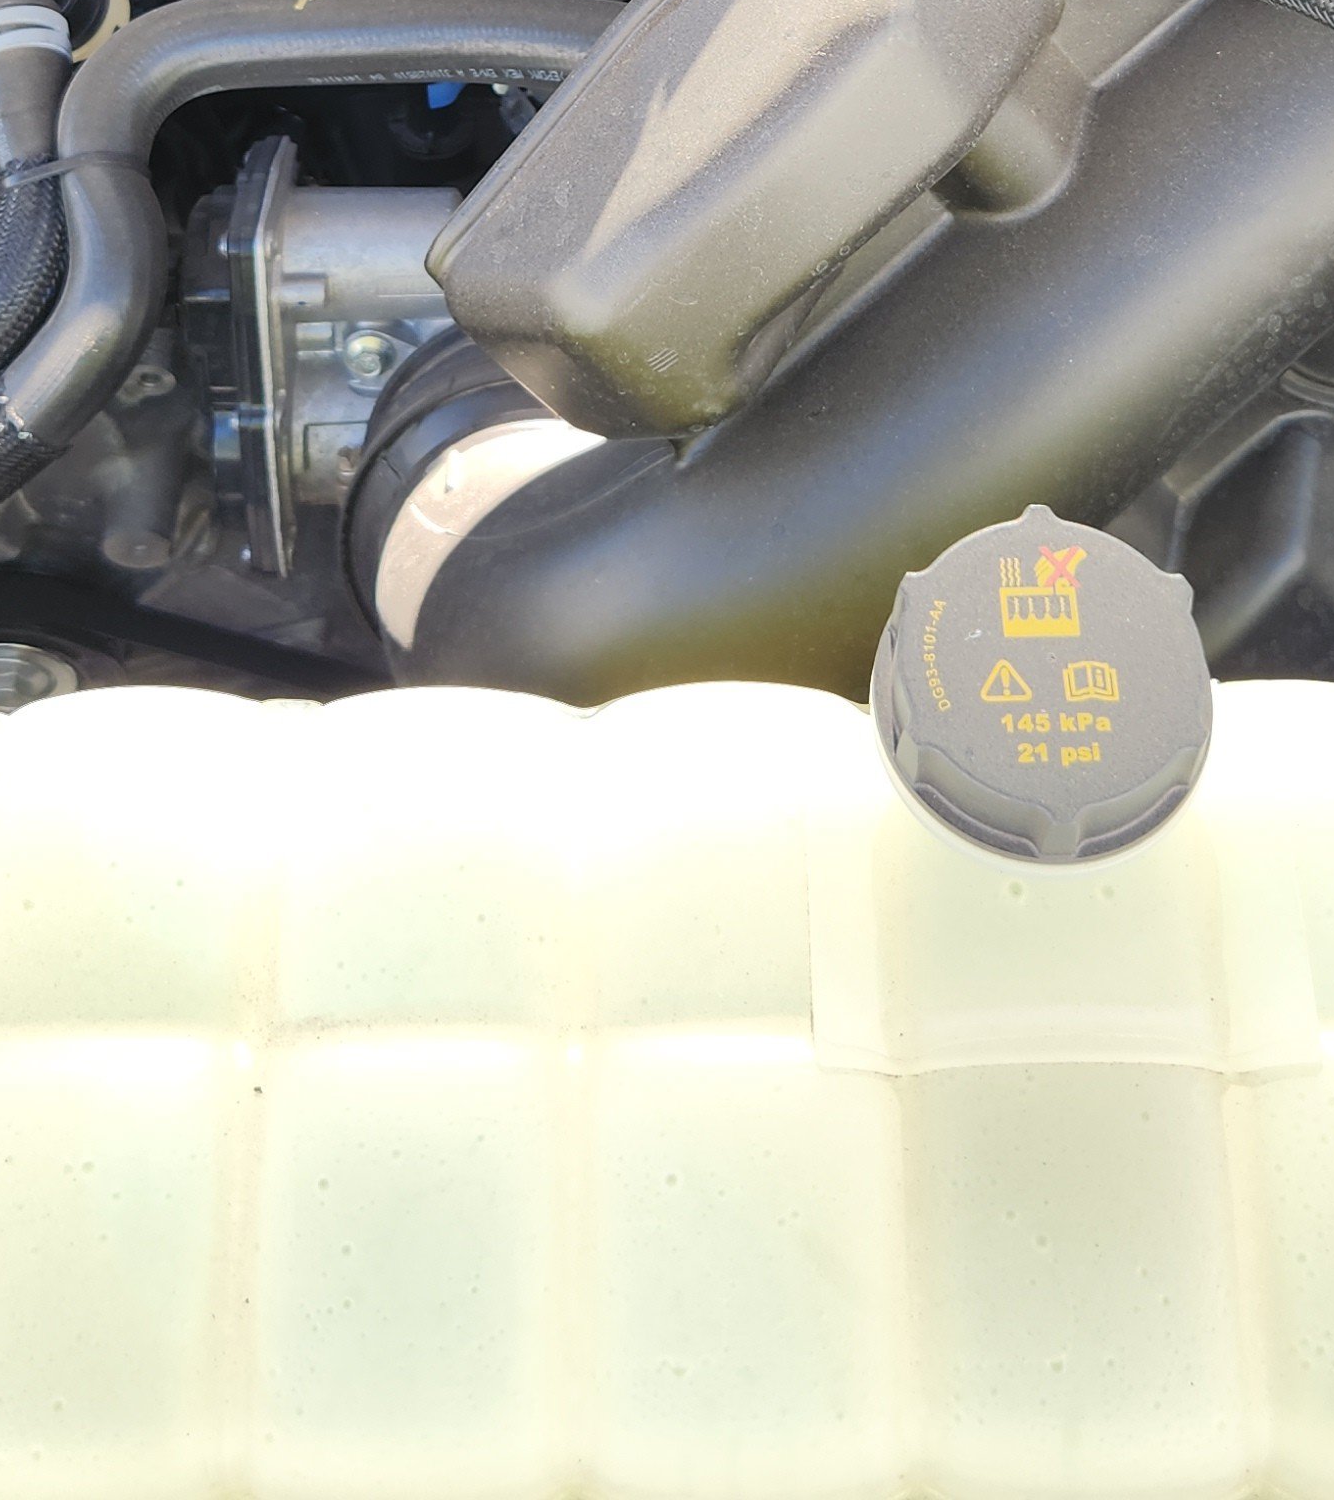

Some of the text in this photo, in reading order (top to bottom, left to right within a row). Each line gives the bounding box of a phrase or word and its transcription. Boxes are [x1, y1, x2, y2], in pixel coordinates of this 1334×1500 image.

[923, 599, 951, 712] DG93-8101-AA
[1001, 713, 1112, 733] 145 kPa
[1017, 742, 1101, 766] 21 psi
